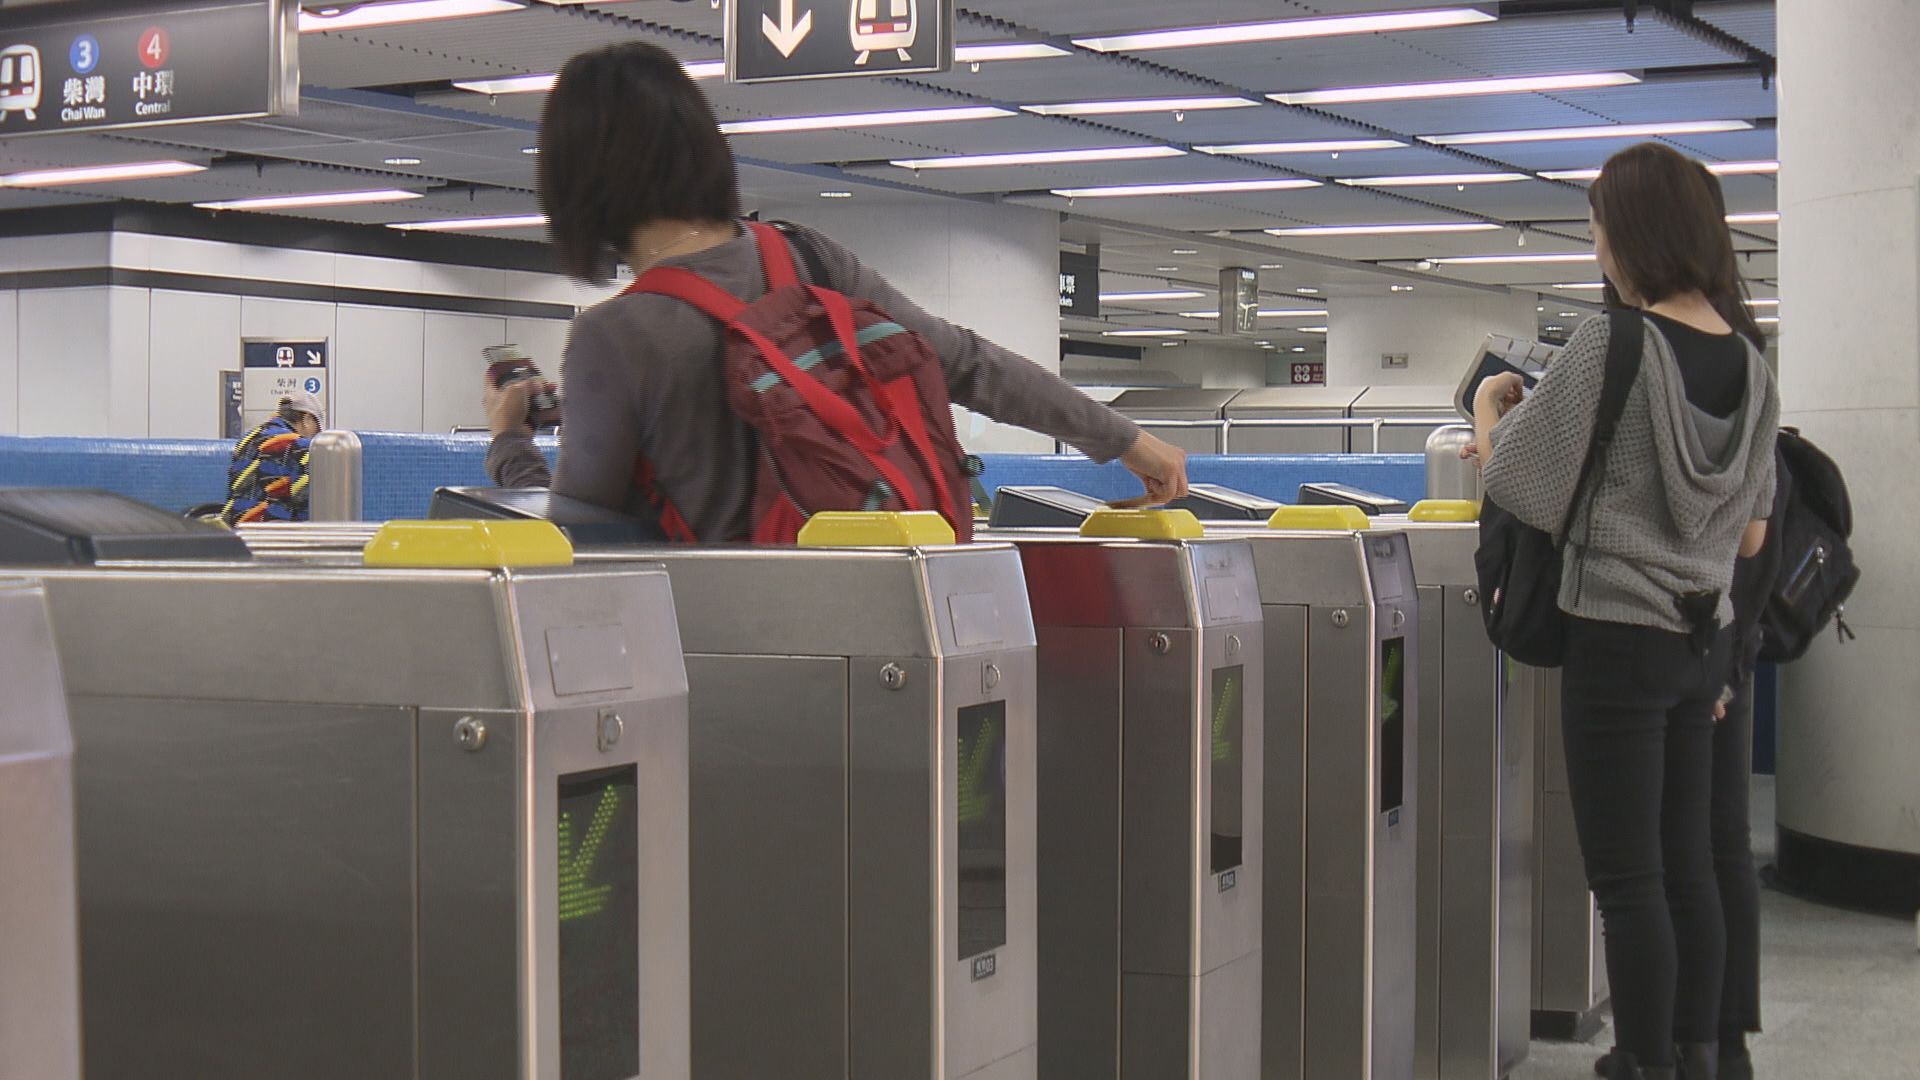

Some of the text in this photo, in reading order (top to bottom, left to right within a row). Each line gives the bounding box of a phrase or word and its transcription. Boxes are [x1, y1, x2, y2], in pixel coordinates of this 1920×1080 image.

[77, 39, 92, 68] 3
[146, 33, 161, 60] 4
[63, 75, 105, 105] 柴灣
[132, 69, 174, 99] 中環
[61, 106, 105, 121] Chai Wan
[135, 100, 171, 115] Central
[308, 380, 316, 392] 3
